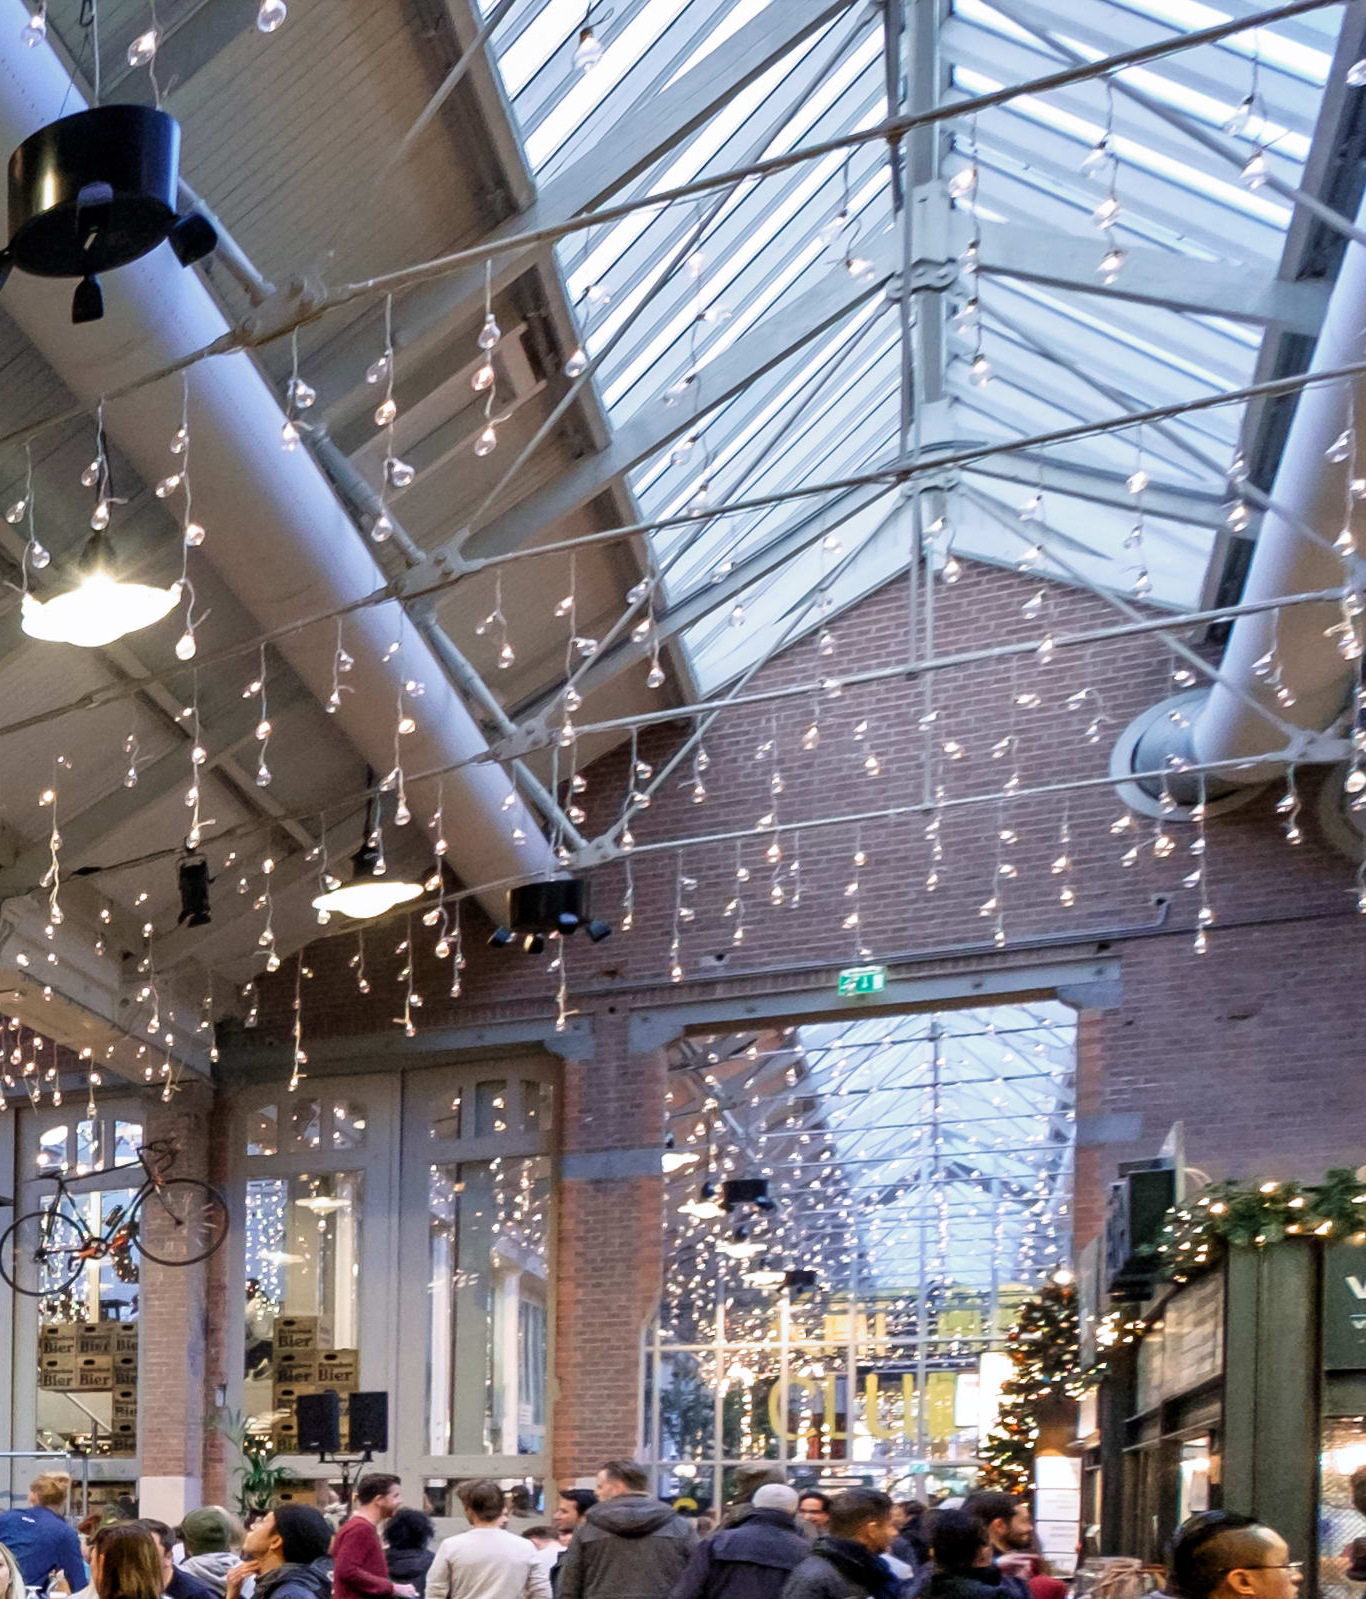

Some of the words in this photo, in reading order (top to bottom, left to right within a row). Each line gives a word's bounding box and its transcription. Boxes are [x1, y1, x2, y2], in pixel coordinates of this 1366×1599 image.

[43, 1341, 75, 1354] Bier
[278, 1335, 313, 1348] Bier
[43, 1374, 74, 1387] Bier
[80, 1374, 111, 1386] Bier
[277, 1370, 312, 1383] Bier
[318, 1369, 353, 1382] Bier
